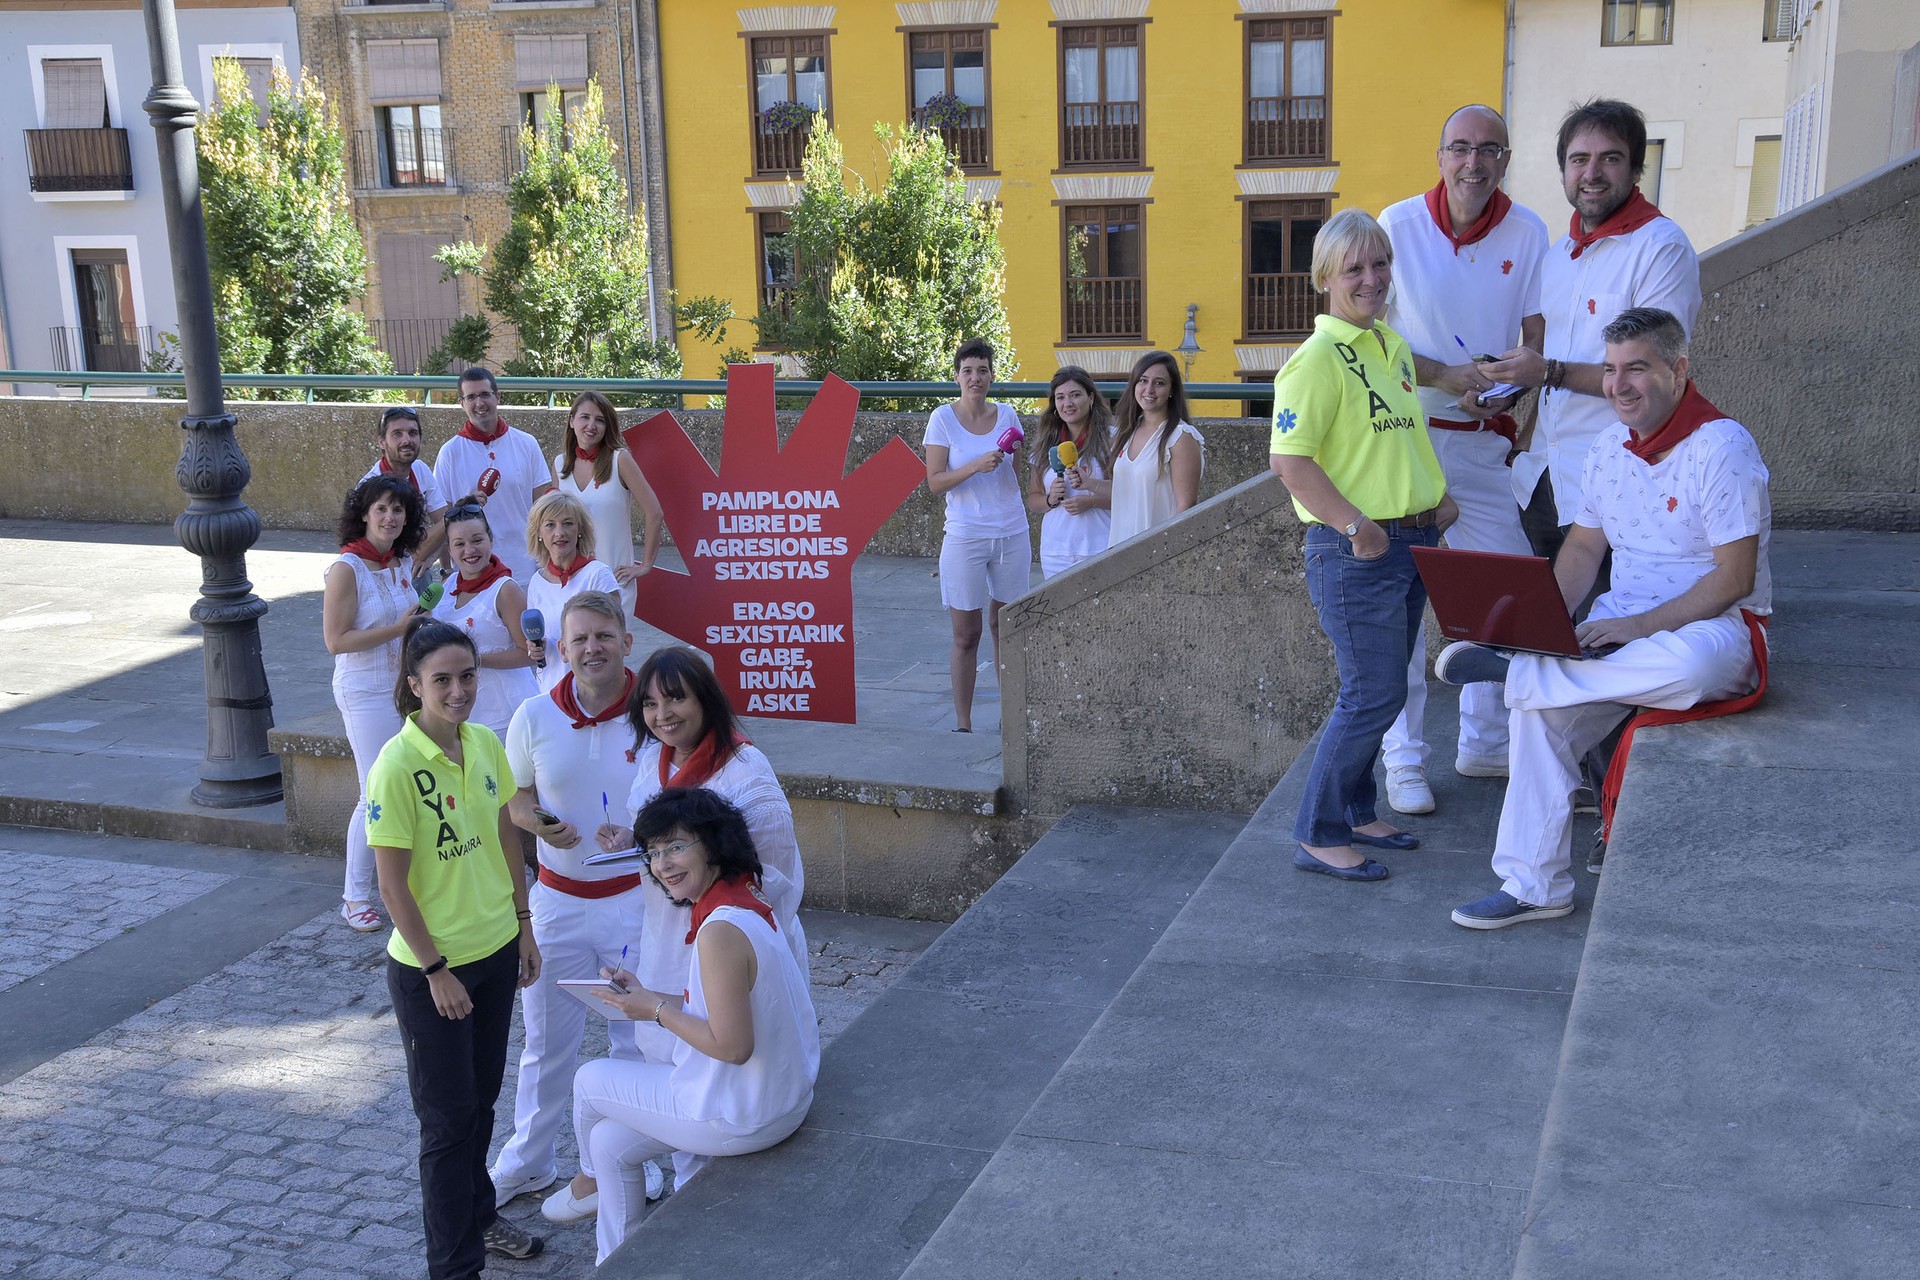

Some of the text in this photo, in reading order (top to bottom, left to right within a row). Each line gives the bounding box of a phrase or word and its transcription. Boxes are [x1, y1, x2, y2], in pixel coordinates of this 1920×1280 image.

[702, 490, 840, 511] PAMPLONA
[718, 513, 822, 534] LIBRE DE
[694, 537, 848, 558] AGRESIONES
[715, 560, 830, 580] SEXISTAS
[733, 601, 815, 621] ERASO
[705, 624, 845, 644] SEXISTARIK
[740, 648, 813, 669] GABE,
[739, 666, 816, 690] IRUÑA
[747, 694, 810, 712] ASKE
